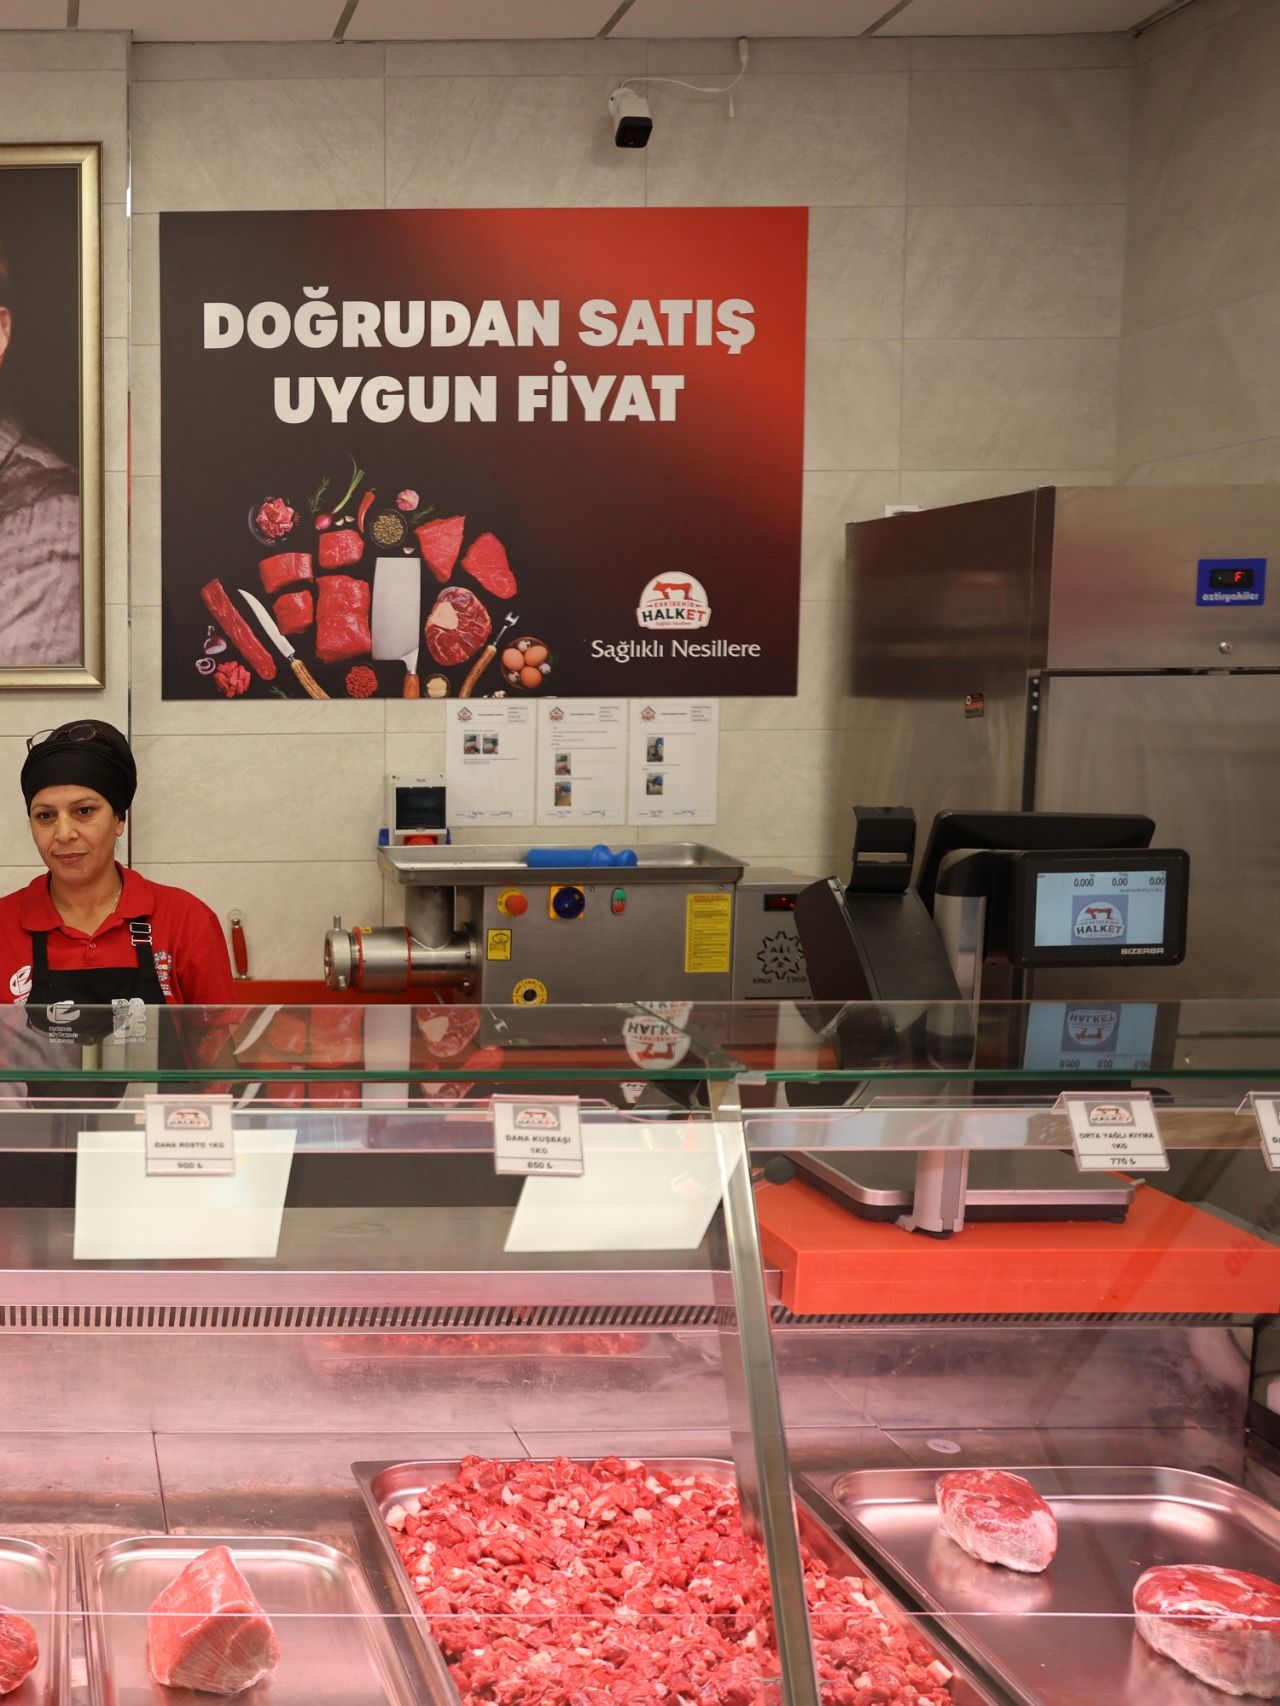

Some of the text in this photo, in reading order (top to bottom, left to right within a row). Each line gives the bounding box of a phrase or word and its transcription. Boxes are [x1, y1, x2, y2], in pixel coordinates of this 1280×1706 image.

[203, 285, 756, 355] DOĞRUDAN SATIŞ
[273, 359, 685, 424] UYGUN FİYAT
[642, 608, 706, 622] HALKET
[591, 639, 761, 664] Sağlıklı Nesillere
[1076, 924, 1122, 935] HALKET
[505, 1134, 572, 1145] DANA KUŞBAŞI
